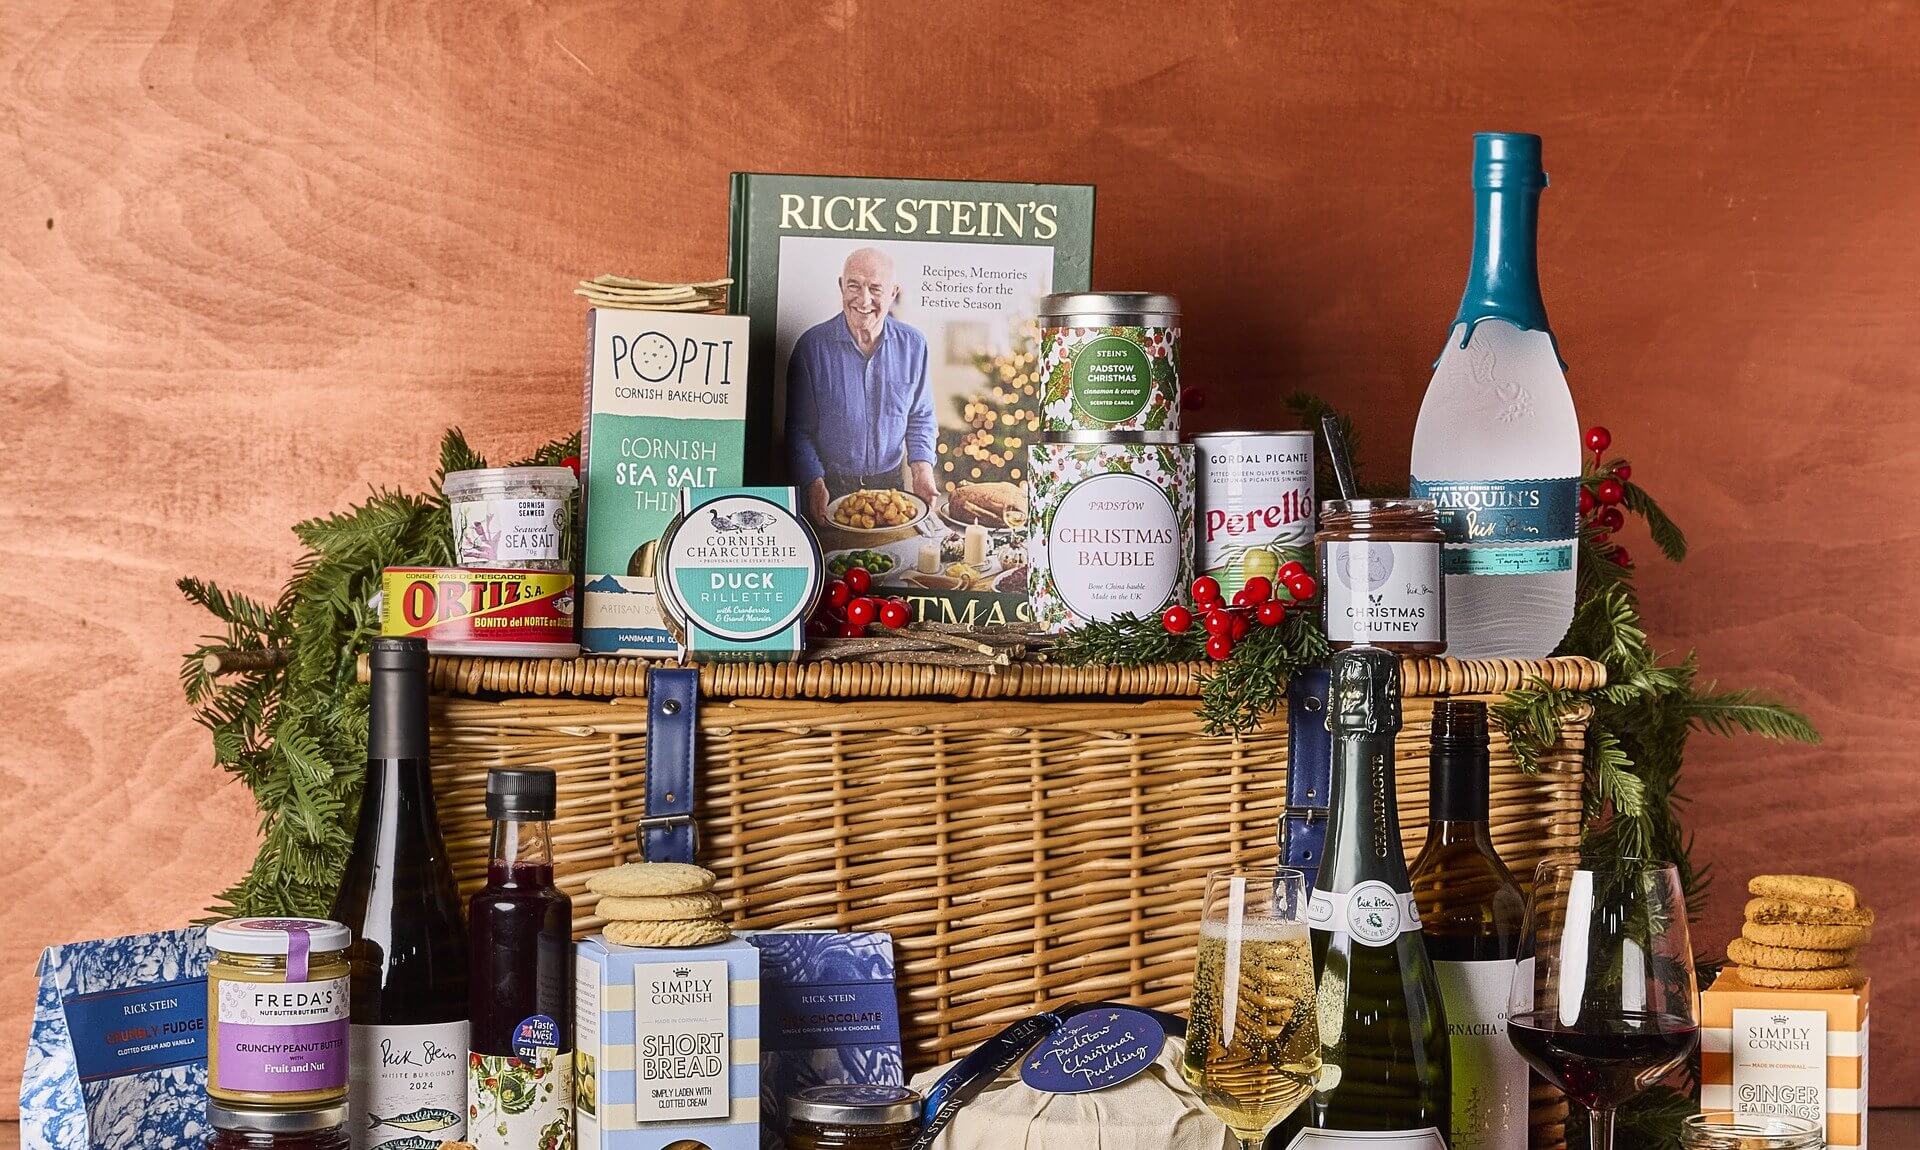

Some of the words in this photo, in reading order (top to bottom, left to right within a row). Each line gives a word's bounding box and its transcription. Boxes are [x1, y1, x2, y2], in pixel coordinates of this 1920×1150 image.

[779, 194, 886, 232] RICK
[894, 197, 1058, 240] STEIN'S
[922, 265, 968, 280] Recipes,
[972, 267, 1028, 280] Memories
[922, 281, 932, 292] &
[936, 281, 973, 294] Stories
[976, 281, 993, 294] for
[996, 283, 1013, 295] the
[922, 297, 960, 309] Festive
[963, 298, 1002, 310] Season
[612, 332, 733, 385] POPTI
[1090, 365, 1134, 373] PADSTOW
[1088, 374, 1137, 382] CHRISTMAS
[615, 387, 663, 400] CORNISH
[669, 389, 728, 404] BAKEHOUSE
[621, 438, 716, 461] CORNISH
[1211, 455, 1260, 464] GORDAL
[1266, 453, 1308, 463] PICANTE
[616, 462, 657, 486] SEA
[668, 465, 717, 488] SALT
[1088, 500, 1144, 510] PADSTOW
[1207, 488, 1312, 542] Perelló
[514, 525, 547, 533] Seaweed
[505, 535, 528, 548] SEA
[532, 534, 554, 548] SALT
[707, 537, 775, 546] CORNISH
[1059, 528, 1173, 544] CHRISTMAS
[687, 547, 796, 557] CHARCUTERIE
[1079, 551, 1155, 567] BAUBLE
[711, 572, 774, 589] DUCK
[1088, 582, 1104, 590] Bone
[1105, 582, 1125, 590] China
[1127, 582, 1146, 590] bauble
[701, 592, 783, 602] RILLETTE
[1091, 592, 1109, 600] Made
[403, 580, 522, 628] ORTIZ
[524, 585, 544, 598] S.A.
[600, 605, 640, 614] ARTISAN
[716, 606, 732, 614] with
[733, 606, 770, 614] Cranberries
[475, 617, 507, 627] BONITO
[510, 617, 522, 627] del
[524, 617, 548, 626] NORTE
[723, 614, 745, 622] Grand
[1354, 622, 1418, 632] CHUTNEY
[1372, 754, 1388, 858] CHAMPAGNE
[652, 980, 712, 994] SIMPLY
[255, 991, 332, 1007] FREDA'S
[652, 993, 712, 1005] CORNISH
[802, 995, 825, 1003] RICK
[828, 994, 856, 1002] STEIN
[124, 1003, 147, 1015] RICK
[149, 998, 178, 1011] STEIN
[811, 1012, 882, 1023] CHOCOLATE
[163, 1018, 204, 1034] FUDGE
[533, 1020, 553, 1030] Taste
[532, 1031, 552, 1040] West
[1749, 1027, 1810, 1040] SIMPLY
[118, 1047, 140, 1056] CLOTTED
[141, 1043, 159, 1053] CREAM
[172, 1038, 195, 1046] VANILLA
[236, 1043, 281, 1053] CRUNCHY
[283, 1043, 319, 1052] PEANUT
[643, 1033, 723, 1057] SHORT
[1044, 1026, 1110, 1064] Padstow
[1749, 1039, 1810, 1050] CORNISH
[1063, 1032, 1135, 1074] Christmas
[265, 1064, 289, 1073] Fruit
[291, 1063, 308, 1072] and
[310, 1062, 325, 1071] Nut
[643, 1056, 722, 1080] BREAD
[1072, 1046, 1148, 1085] Pudding
[410, 1082, 433, 1090] 2024
[651, 1088, 673, 1098] SIMPLY
[675, 1087, 694, 1097] LADEN
[696, 1086, 712, 1096] WITH
[1739, 1084, 1819, 1104] GINGER
[658, 1098, 686, 1108] CLOTTED
[687, 1097, 708, 1107] CREAM
[927, 1098, 963, 1134] STEIN
